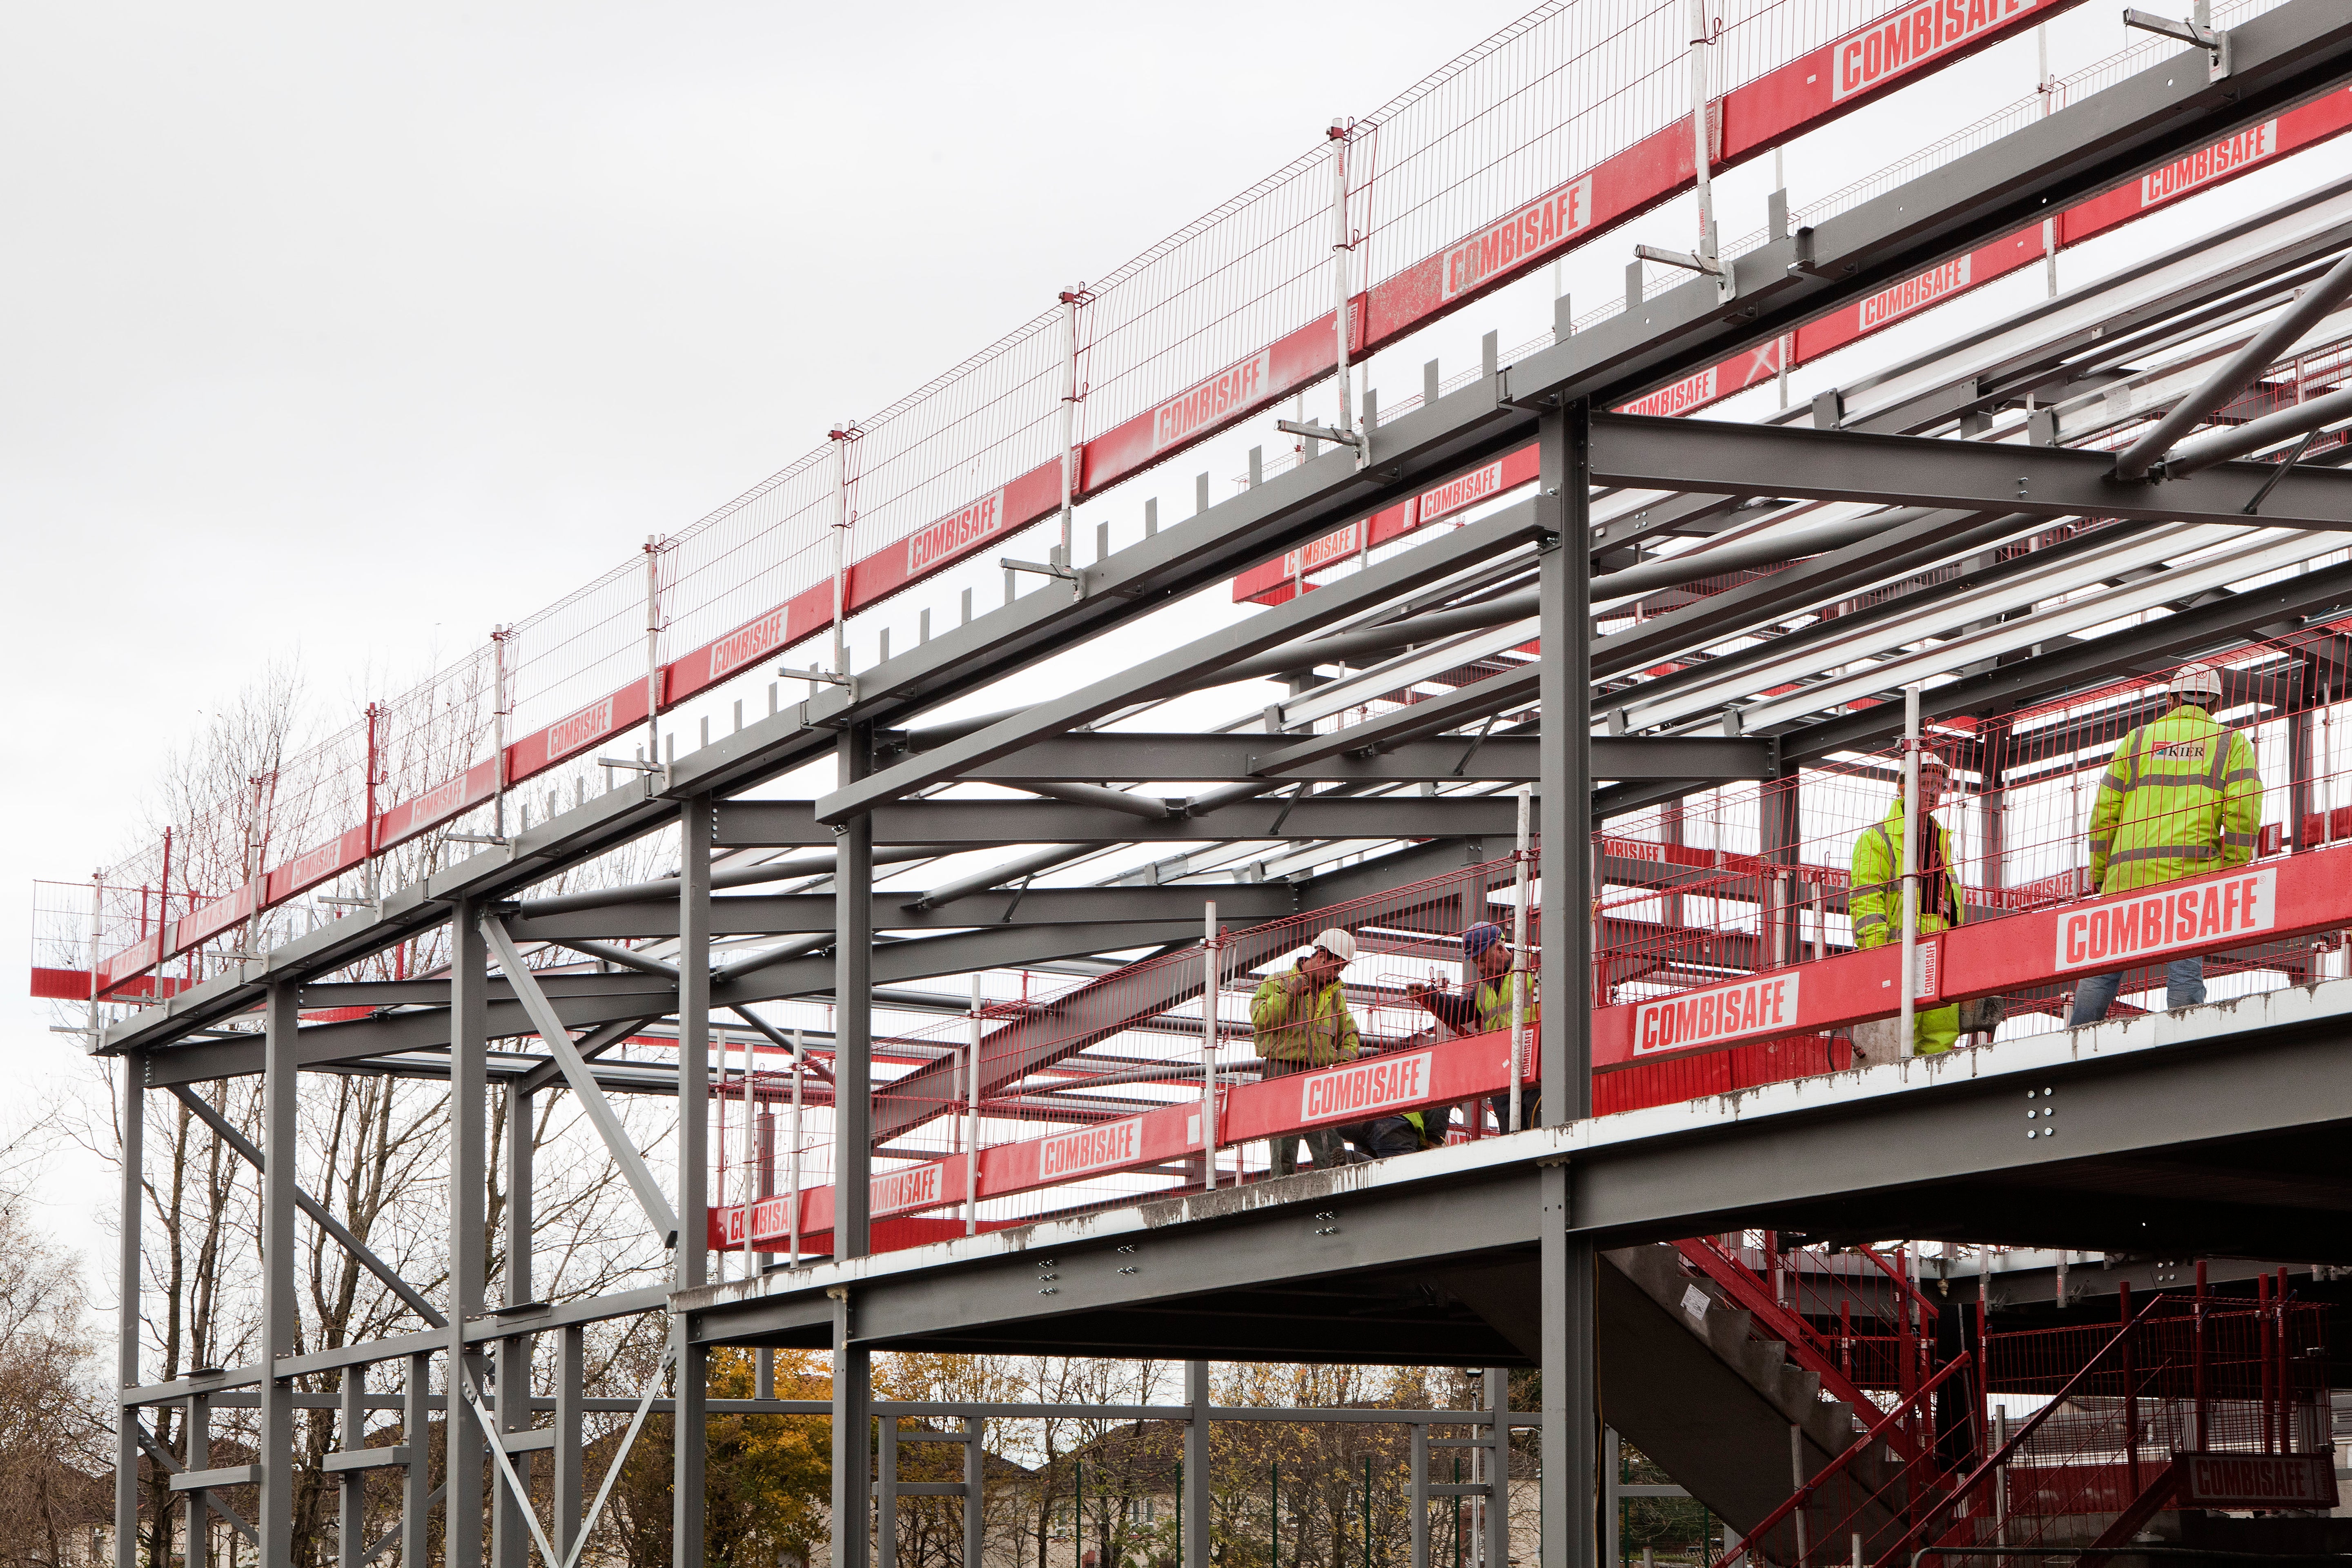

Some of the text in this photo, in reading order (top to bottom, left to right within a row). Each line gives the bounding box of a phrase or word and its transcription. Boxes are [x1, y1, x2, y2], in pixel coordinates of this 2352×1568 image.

[1842, 0, 2020, 92] COMBISA
[2149, 124, 2265, 200] COMBISAFE
[1450, 186, 1579, 293] COMBISAFE
[1865, 257, 1962, 325] COMBISAFE
[1158, 358, 1261, 445] COMBISAFE
[1425, 467, 1495, 518] COMBISAFE
[912, 496, 996, 569] COMBISAFE
[1287, 528, 1350, 574] CMBISAFE
[714, 613, 782, 675] COMBISAFE
[551, 702, 608, 756] COMBISAFE
[2168, 746, 2203, 757] KIER
[414, 779, 462, 824] COMBISAFE
[294, 843, 337, 886] COMBISAFE
[2066, 877, 2258, 964] COMBISAFE
[1924, 944, 1935, 994] COMBISAFE
[1642, 980, 1785, 1049] COMBISAFE
[1523, 1031, 1532, 1075] COMBISAFE
[1308, 1058, 1421, 1116] COMBISAFE
[1045, 1123, 1133, 1175] COMBISAFE
[870, 1168, 935, 1212] OMBISAFE
[2196, 1459, 2305, 1497] COMBISAFE
